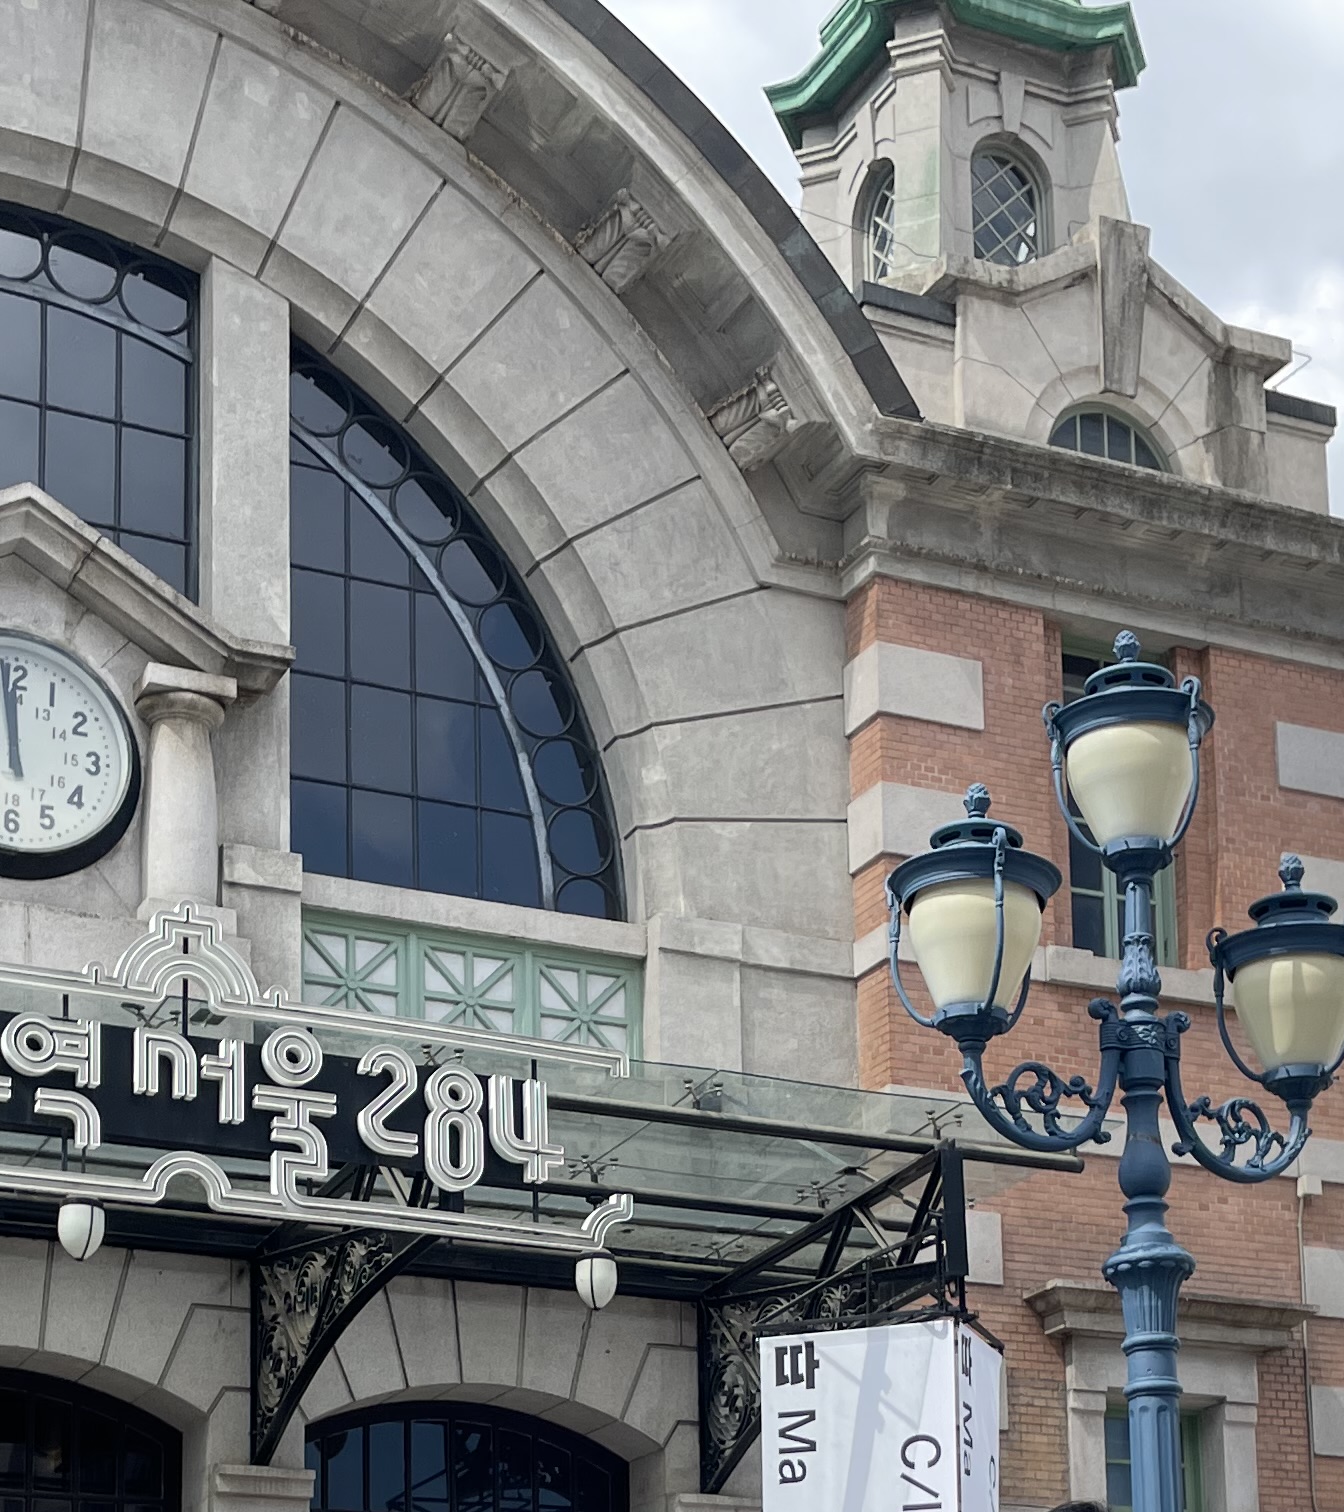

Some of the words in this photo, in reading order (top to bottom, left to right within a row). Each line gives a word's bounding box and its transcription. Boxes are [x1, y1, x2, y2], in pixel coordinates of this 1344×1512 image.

[49, 681, 55, 707] 1
[35, 707, 51, 721] 13
[71, 711, 88, 737] 2
[85, 751, 101, 776] 3
[67, 785, 84, 809] 4
[3, 808, 20, 834] 6
[39, 805, 55, 830] 5
[777, 1408, 818, 1486] Ma
